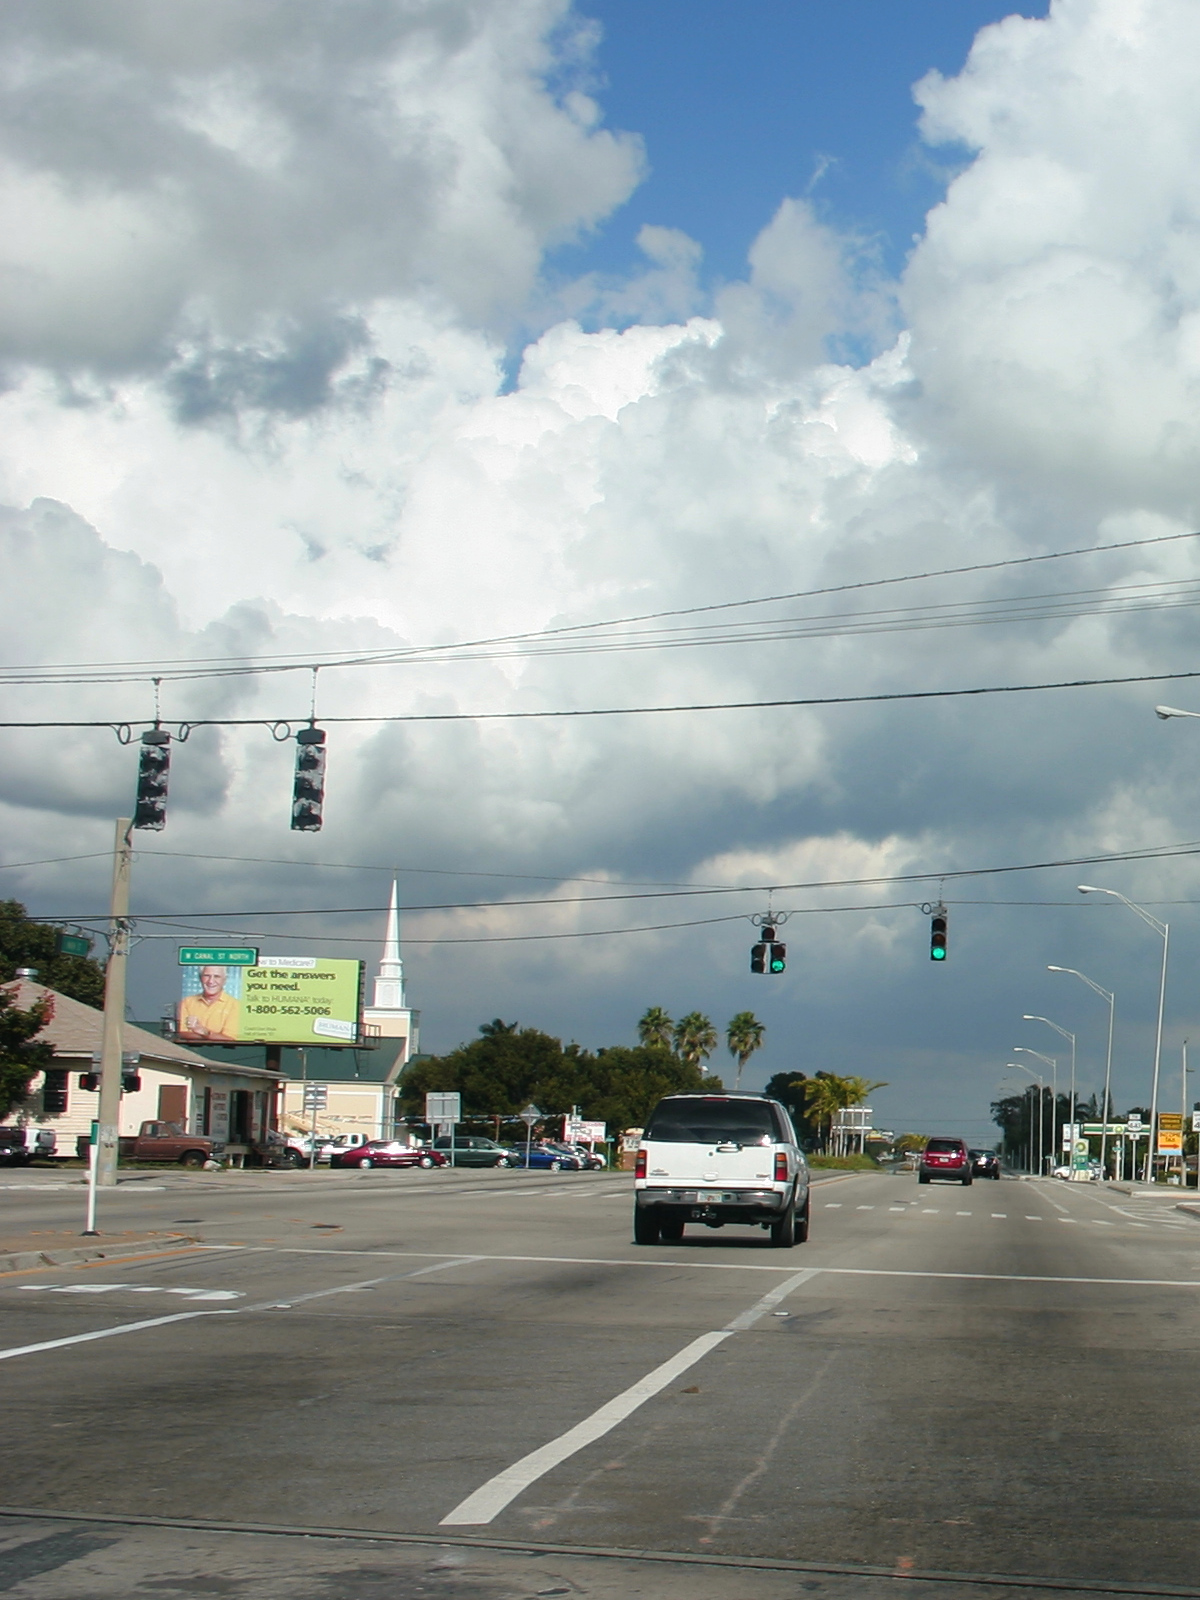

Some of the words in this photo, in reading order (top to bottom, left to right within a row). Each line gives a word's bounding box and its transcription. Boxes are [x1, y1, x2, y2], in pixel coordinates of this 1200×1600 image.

[194, 952, 214, 960] CANAL
[218, 952, 226, 960] ST
[247, 969, 267, 979] Get
[269, 969, 288, 979] the
[290, 972, 337, 981] answers
[246, 982, 268, 992] you
[269, 981, 300, 991] need.
[246, 1005, 331, 1016] 1-800-562-5006
